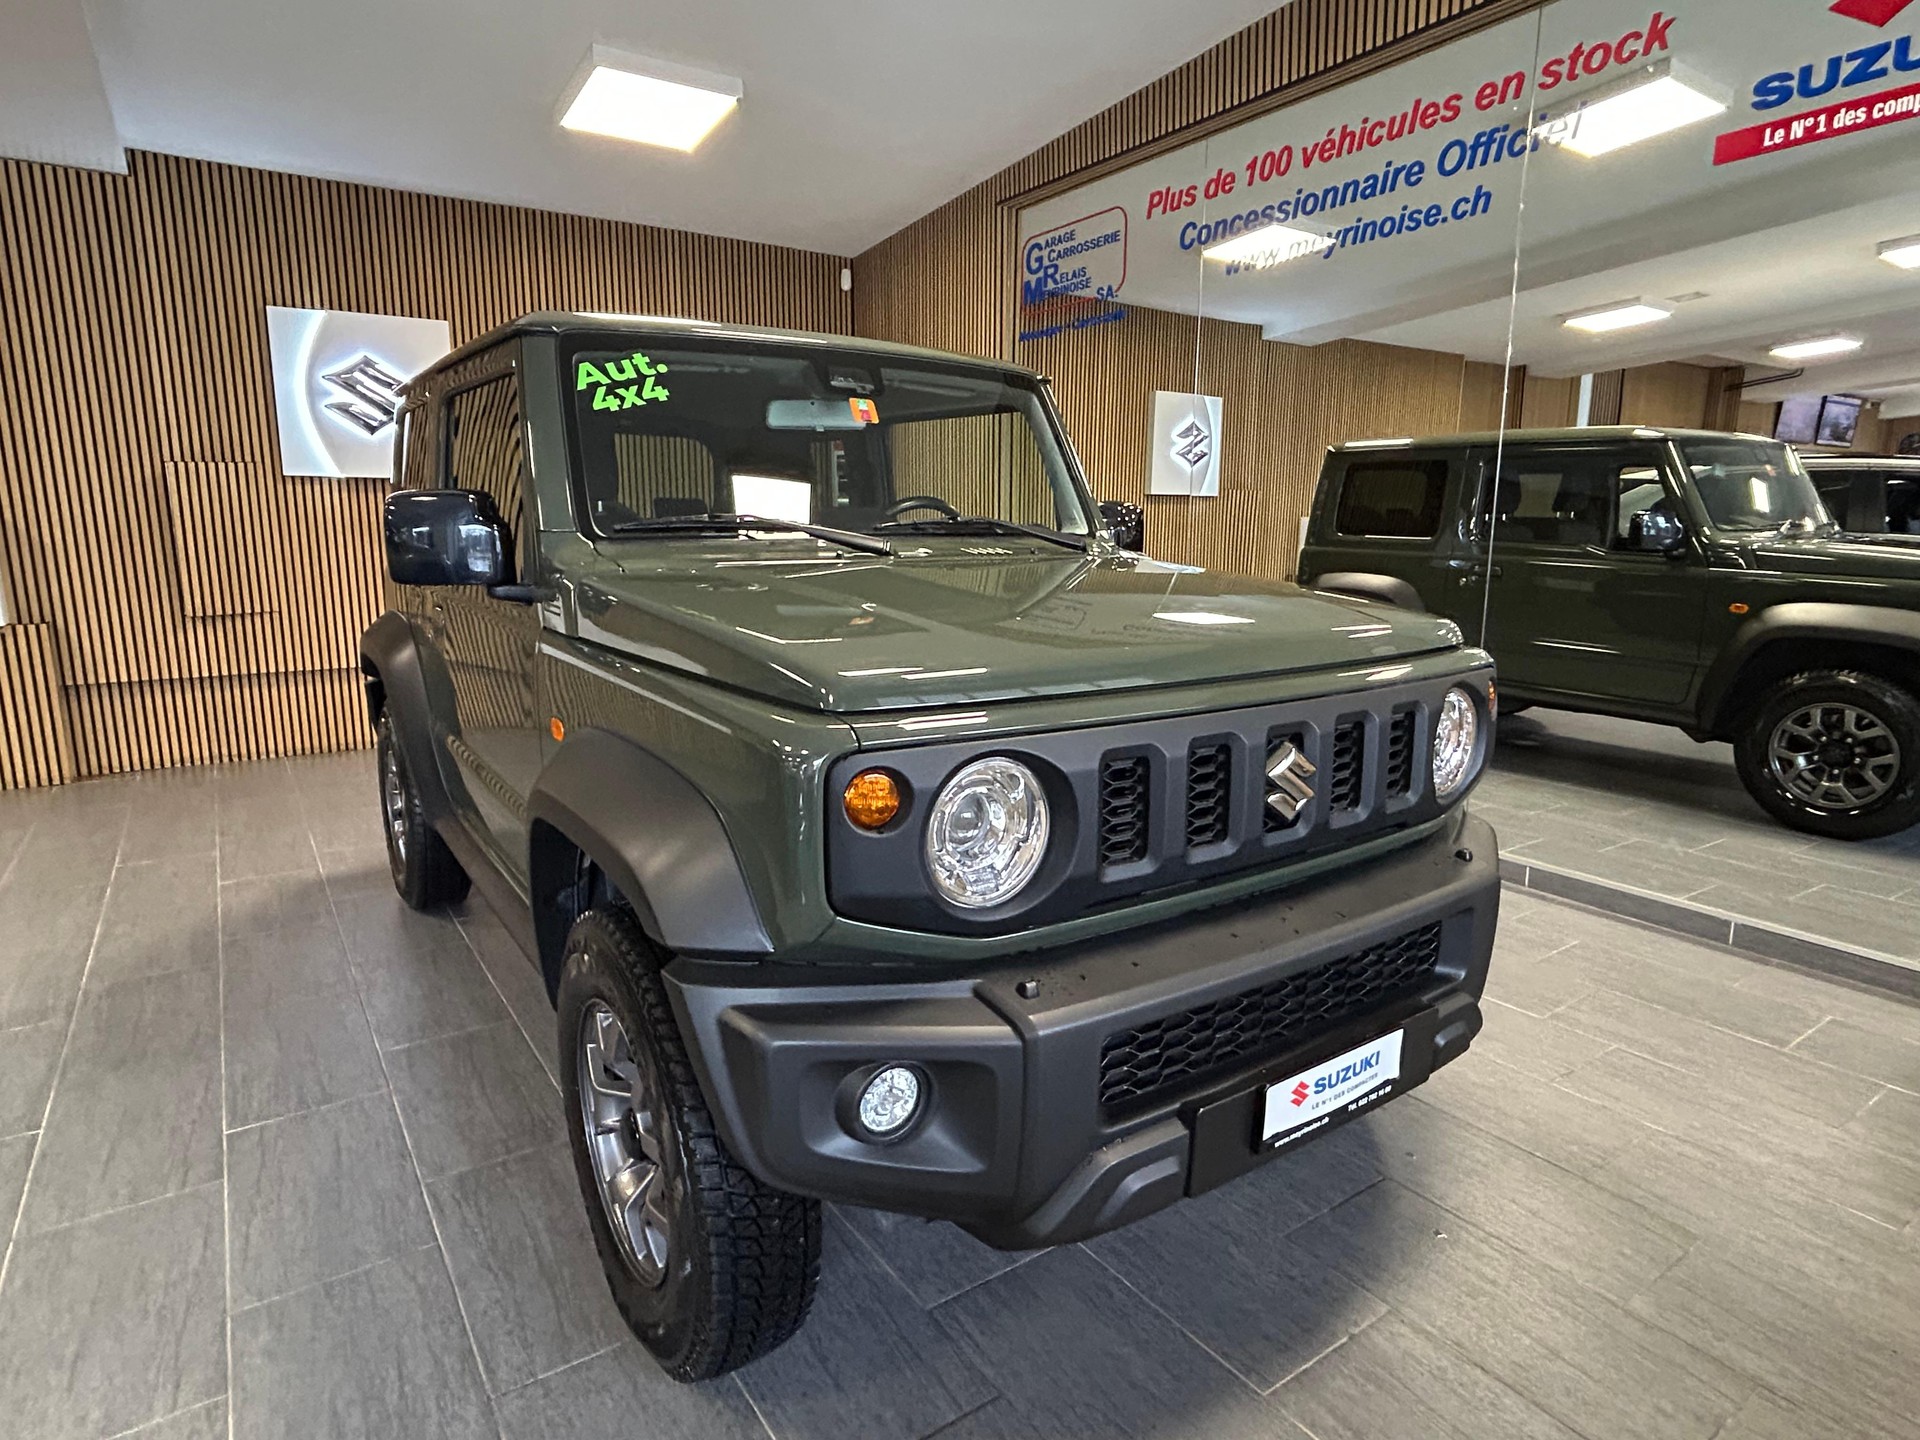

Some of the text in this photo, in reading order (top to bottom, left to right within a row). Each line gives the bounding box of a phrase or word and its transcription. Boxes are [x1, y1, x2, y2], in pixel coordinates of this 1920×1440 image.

[1145, 11, 1677, 220] Plus de 100 véhicules en stock
[1763, 127, 1786, 147] Le
[1833, 107, 1867, 129] des
[1179, 160, 1425, 250] Concessionnaire
[1047, 230, 1121, 263] CARROSSERIE
[576, 352, 669, 391] Aut.
[592, 376, 670, 412] 4x4
[1313, 1050, 1381, 1095] SUZUKI
[1311, 1101, 1320, 1110] LE
